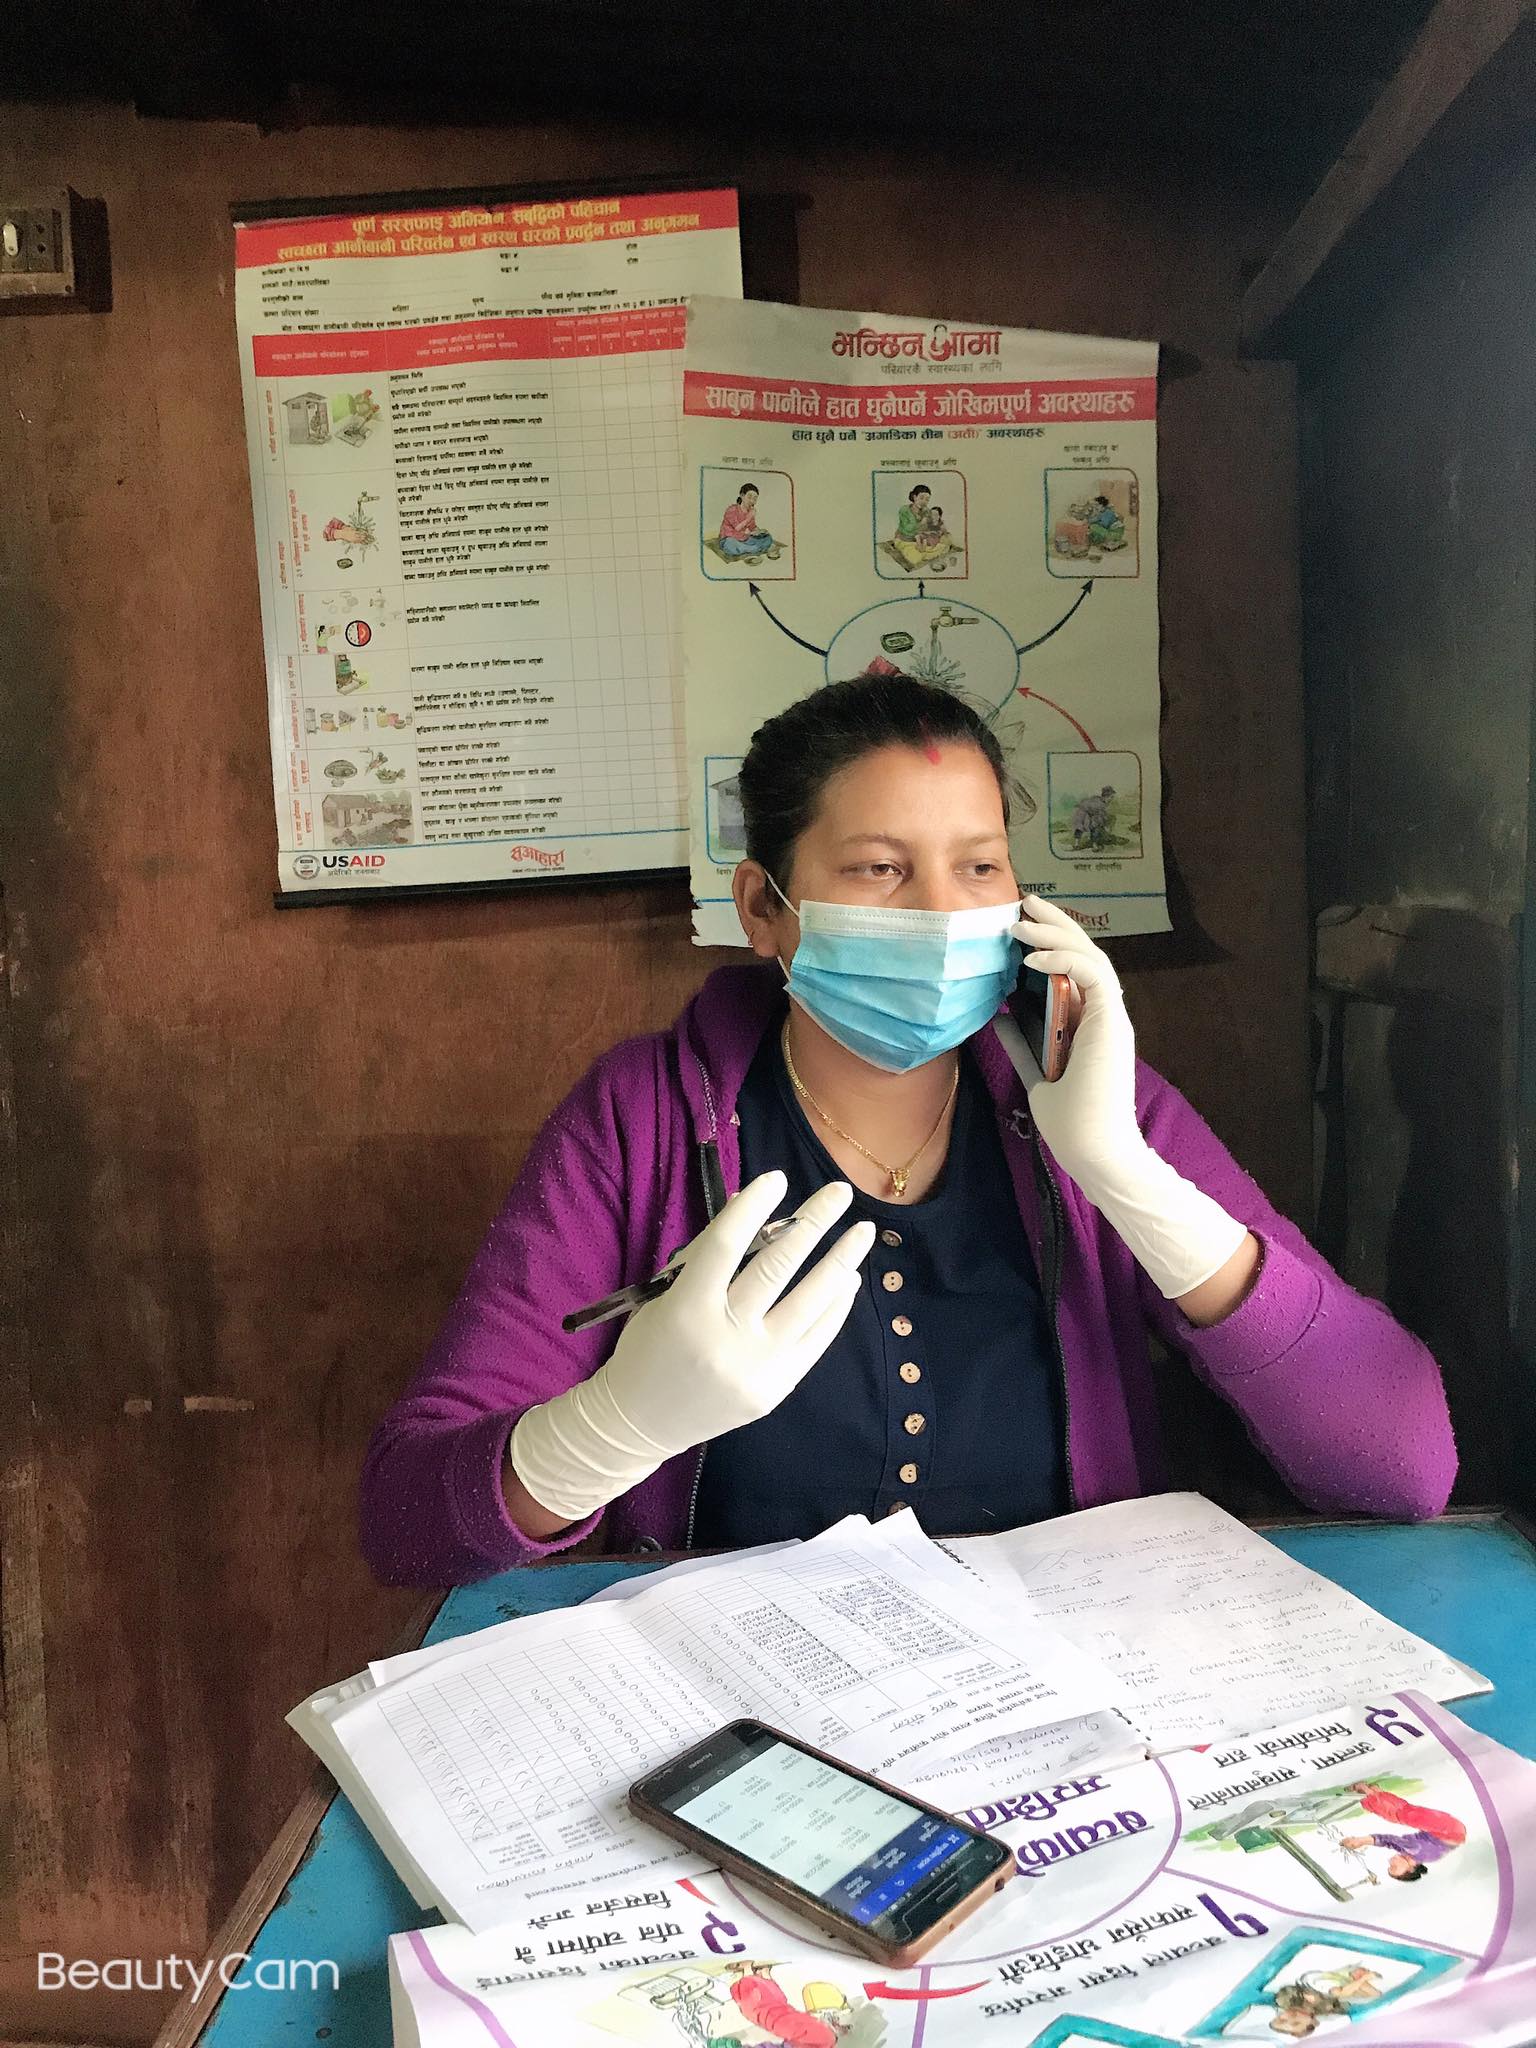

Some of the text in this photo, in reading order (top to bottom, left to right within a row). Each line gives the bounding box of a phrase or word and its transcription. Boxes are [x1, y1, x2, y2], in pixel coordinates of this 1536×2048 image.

[609, 219, 637, 233] तथा
[832, 327, 929, 361] भन्छिन्
[705, 386, 756, 415] साबुन
[762, 388, 821, 418] पानीले
[825, 397, 863, 419] हात
[933, 389, 1032, 421] जोखिमपूर्ण
[1038, 390, 1136, 415] अवस्थाहरु
[792, 429, 813, 441] हात
[322, 855, 385, 868] USAID
[1214, 1720, 1351, 1768] मिचिमिची हात
[1186, 1765, 1298, 1811] साबुनपानीले
[1106, 1902, 1200, 1944] सफासँग
[514, 1919, 684, 1964] पनि चर्पीमा नै
[1145, 1934, 1228, 1969] बच्चाले
[475, 1963, 588, 1991] दिसालाई
[598, 1949, 700, 1973] बच्चाको
[1078, 1961, 1138, 1991] दिसा
[980, 1984, 1073, 2020] गरेपछि
